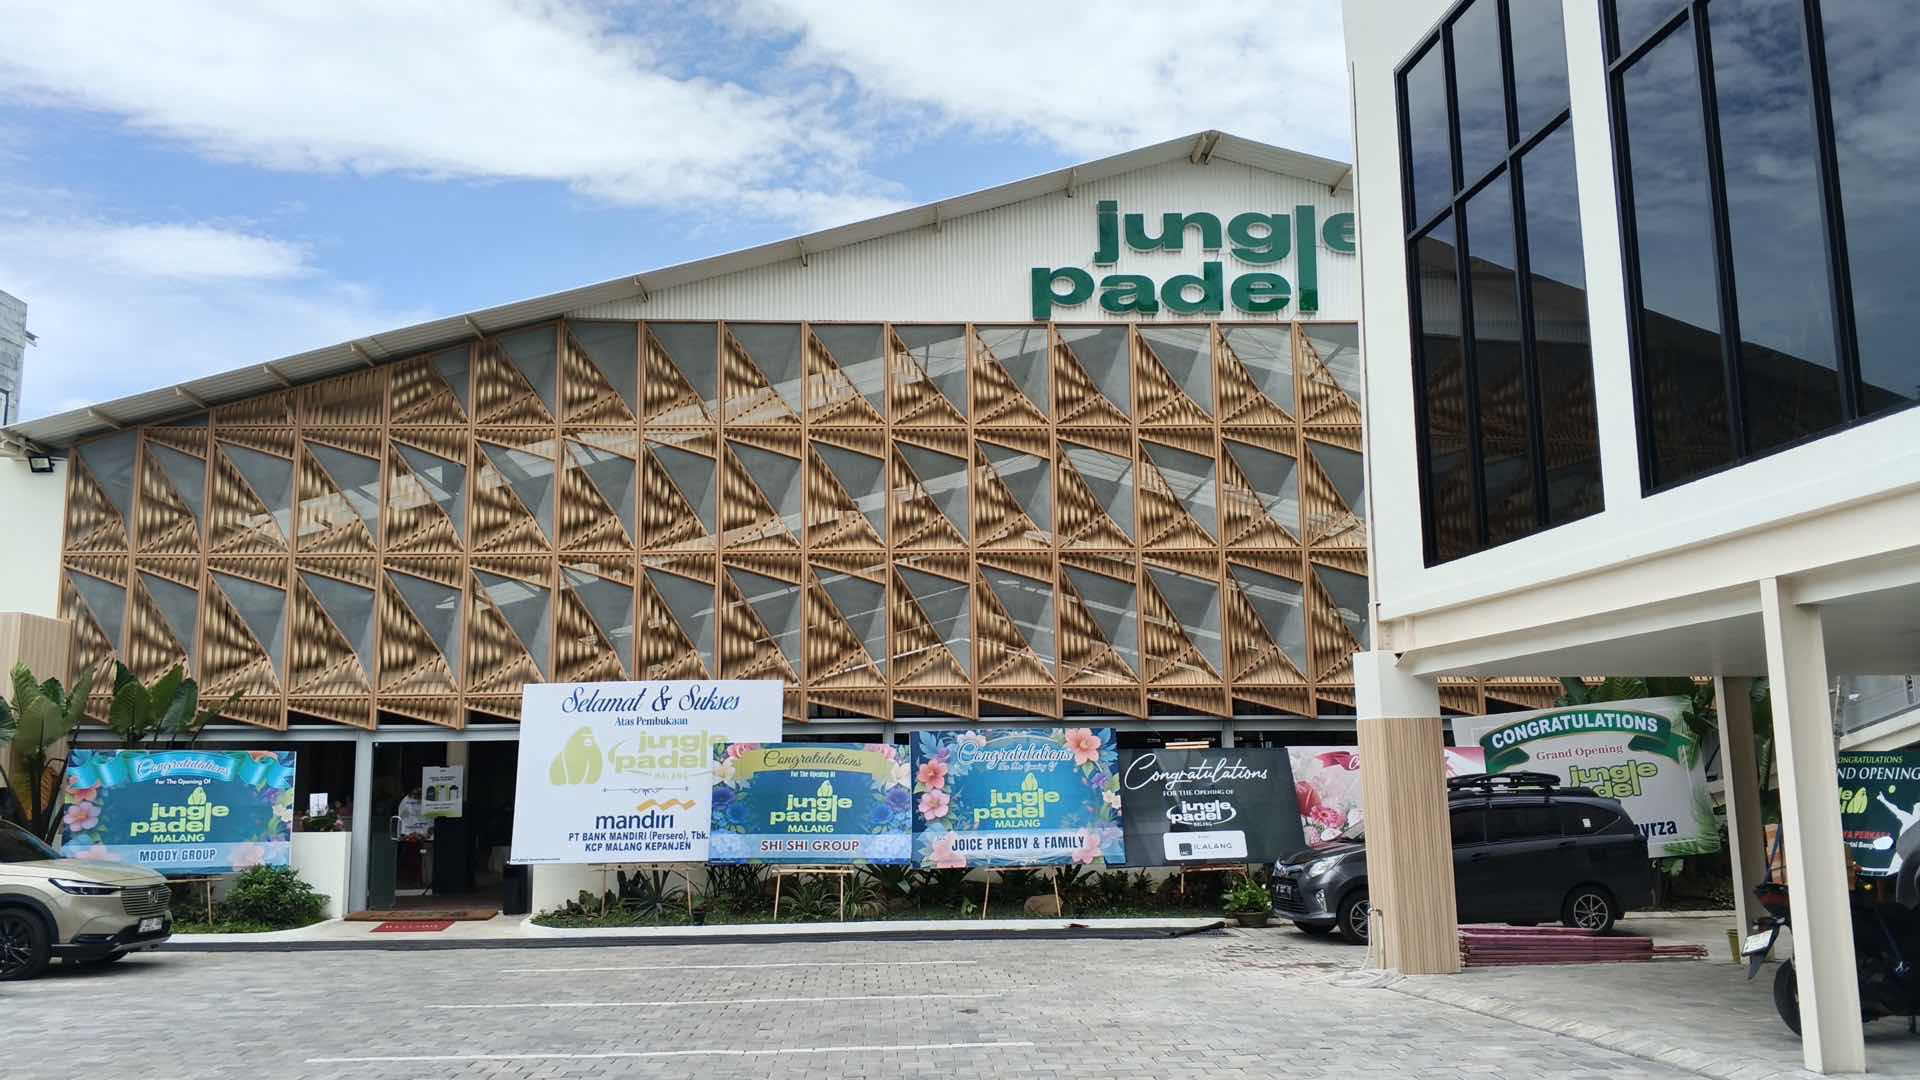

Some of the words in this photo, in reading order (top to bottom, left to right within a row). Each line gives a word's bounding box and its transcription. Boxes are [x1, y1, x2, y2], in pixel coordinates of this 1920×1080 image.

[1094, 200, 1356, 266] jungle
[1031, 260, 1319, 321] padel
[562, 686, 648, 713] Selamat
[652, 685, 672, 711] &
[678, 684, 740, 711] Sukses
[614, 717, 634, 727] Atas
[636, 716, 689, 727] Pembukaan
[1491, 713, 1659, 749] CONGRATULATIONS
[763, 750, 862, 768] Congratulations
[957, 742, 1074, 770] Congratulations
[1536, 748, 1573, 761] Grand
[1575, 745, 1624, 758] Opening
[1839, 755, 1904, 764] ONGRATULATIONS
[136, 758, 230, 777] Congratulations
[615, 750, 708, 774] padel
[1124, 753, 1268, 790] Congratulations
[1569, 760, 1658, 788] jungle
[1858, 766, 1920, 780] OPENING
[178, 778, 203, 786] Opening
[1592, 780, 1642, 799] del
[990, 789, 1060, 806] jungle
[1179, 789, 1193, 797] THE
[1194, 788, 1224, 797] OPENING
[1225, 788, 1234, 796] OF
[786, 794, 853, 811] jungle
[1181, 800, 1232, 814] jungle
[150, 802, 229, 820] jungle
[770, 809, 838, 825] padel
[973, 803, 1045, 822] padel
[1170, 810, 1222, 824] padel
[130, 816, 211, 836] padel
[594, 809, 675, 830] mandiri
[994, 820, 1040, 829] MALANG
[568, 832, 580, 841] PT
[582, 832, 607, 841] BANK
[609, 831, 647, 841] MANDIRI
[649, 830, 689, 841] (Persero),
[691, 831, 709, 840] Tbk.
[787, 824, 834, 833] MALANG
[153, 833, 205, 843] MALANG
[760, 840, 784, 851] SHI
[786, 840, 808, 851] SHI
[812, 840, 860, 851] GROUP
[951, 838, 983, 851] JOICE
[987, 837, 1028, 850] PHERDY
[1033, 838, 1040, 849] &
[1044, 836, 1085, 849] FAMILY
[584, 842, 602, 852] KCP
[605, 841, 642, 852] MALANG
[645, 841, 692, 851] KEPANJEN
[139, 850, 178, 862] MOODY
[181, 849, 216, 861] GROUP
